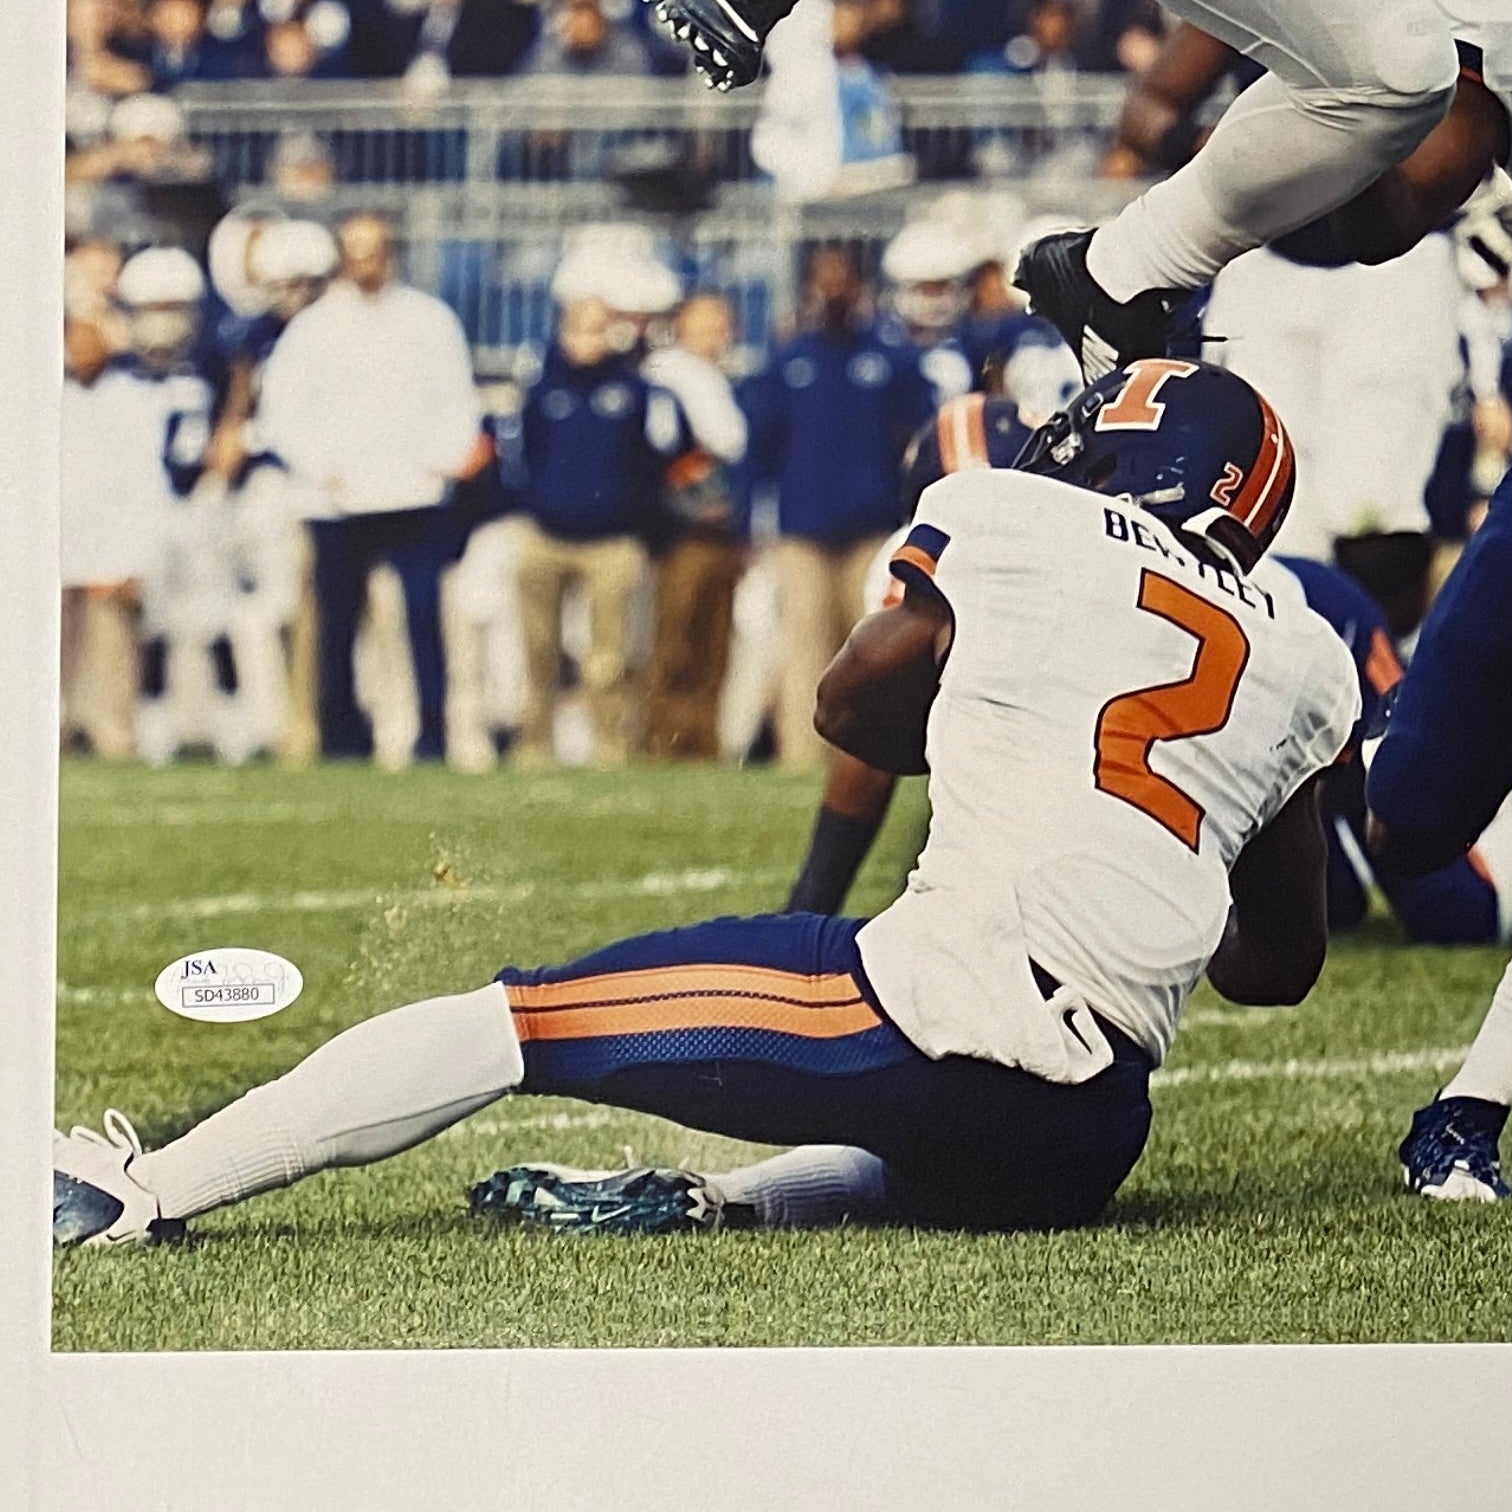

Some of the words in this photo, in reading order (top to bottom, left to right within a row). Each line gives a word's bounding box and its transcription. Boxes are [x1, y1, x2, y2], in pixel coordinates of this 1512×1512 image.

[1210, 461, 1243, 506] 2
[1093, 566, 1251, 855] 2
[180, 959, 218, 979] JSA
[194, 987, 260, 1003] SD43880
